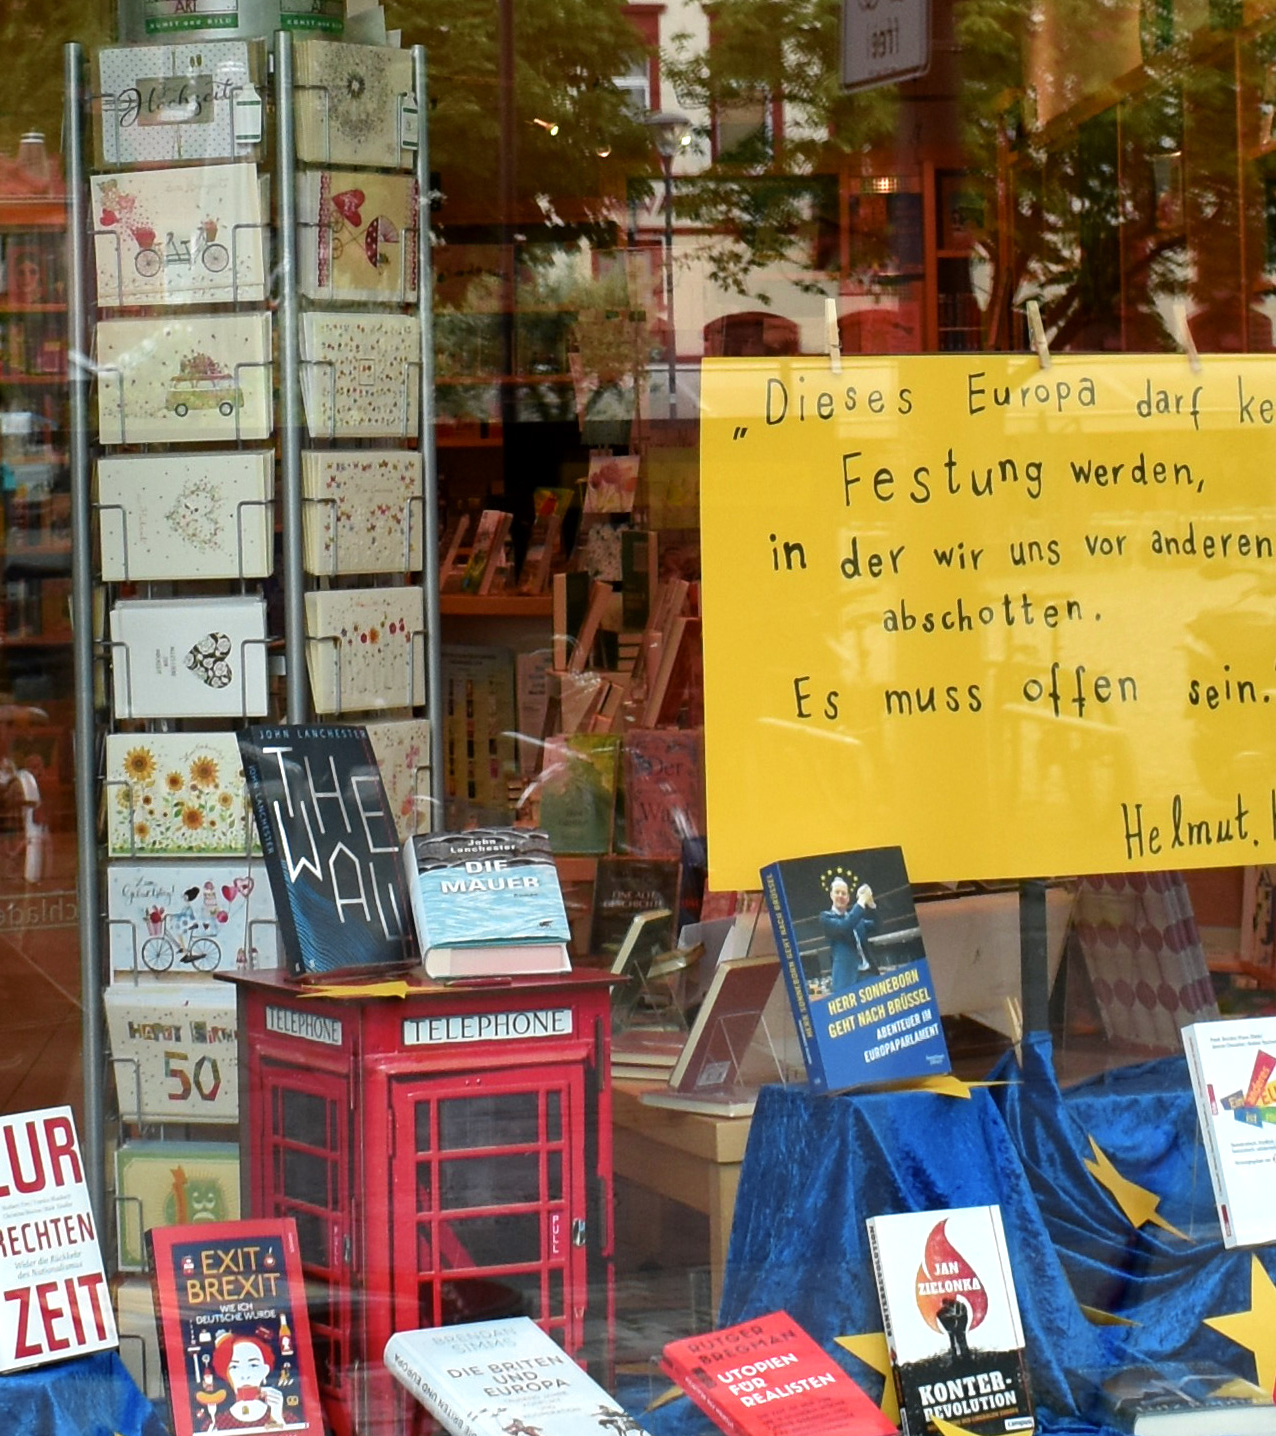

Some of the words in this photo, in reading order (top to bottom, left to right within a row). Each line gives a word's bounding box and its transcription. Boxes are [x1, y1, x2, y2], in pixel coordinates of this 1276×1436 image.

[968, 370, 1098, 416] Europa
[1135, 378, 1204, 430] darf
[841, 447, 1044, 508] Festung
[1070, 453, 1207, 494] werden,
[769, 532, 808, 573] in
[840, 535, 908, 581] der
[934, 540, 985, 572] wir
[1009, 536, 1062, 567] uns
[1085, 531, 1127, 560] vor
[1151, 522, 1275, 560] anderen
[882, 592, 1103, 634] abschotten.
[793, 676, 841, 721] Es
[884, 680, 984, 715] muss
[1022, 662, 1139, 718] offen
[259, 729, 289, 740] JOHN
[297, 728, 368, 739] LANCHESTER
[262, 746, 399, 853] THE
[450, 844, 517, 854] Lanchester
[467, 838, 496, 847] John
[465, 860, 508, 874] DIE
[440, 876, 540, 894] MAUER
[828, 993, 857, 1016] HERR
[859, 969, 920, 1007] SONNEBORN
[268, 1007, 342, 1045] TELEPHONE
[410, 1011, 565, 1042] TELEPHONE
[828, 1017, 856, 1039] GEHT
[858, 1010, 886, 1032] NACH
[888, 987, 931, 1017] BRÜSSEL
[876, 1013, 921, 1040] ABENTEUER
[922, 1009, 932, 1025] IM
[864, 1023, 939, 1064] EUROPAPARLAMENT
[163, 1050, 221, 1101] 50
[201, 1247, 261, 1275] EXIT
[934, 1261, 959, 1276] JAN
[186, 1273, 280, 1304] BREXIT
[918, 1277, 981, 1296] ZIELONKA
[4, 1271, 107, 1360] ZEIT
[196, 1312, 244, 1325] DEUTSCHE
[245, 1309, 276, 1320] WURDE
[220, 1304, 237, 1312] WIE
[237, 1303, 253, 1311] ICH
[432, 1326, 517, 1348] BRENDAN
[451, 1339, 517, 1355] SIMMS
[687, 1325, 764, 1353] RUTGER
[698, 1329, 796, 1365] BREGMAN
[446, 1365, 485, 1379] DIE
[487, 1355, 564, 1377] BRITEN
[494, 1371, 538, 1385] UND
[717, 1352, 799, 1384] UTOPIEN
[483, 1378, 571, 1398] EUROPA
[728, 1377, 768, 1396] FÜR
[740, 1372, 836, 1408] REALISTEN
[918, 1370, 1012, 1407] KONTER-
[923, 1390, 1017, 1422] REVOLUTION
